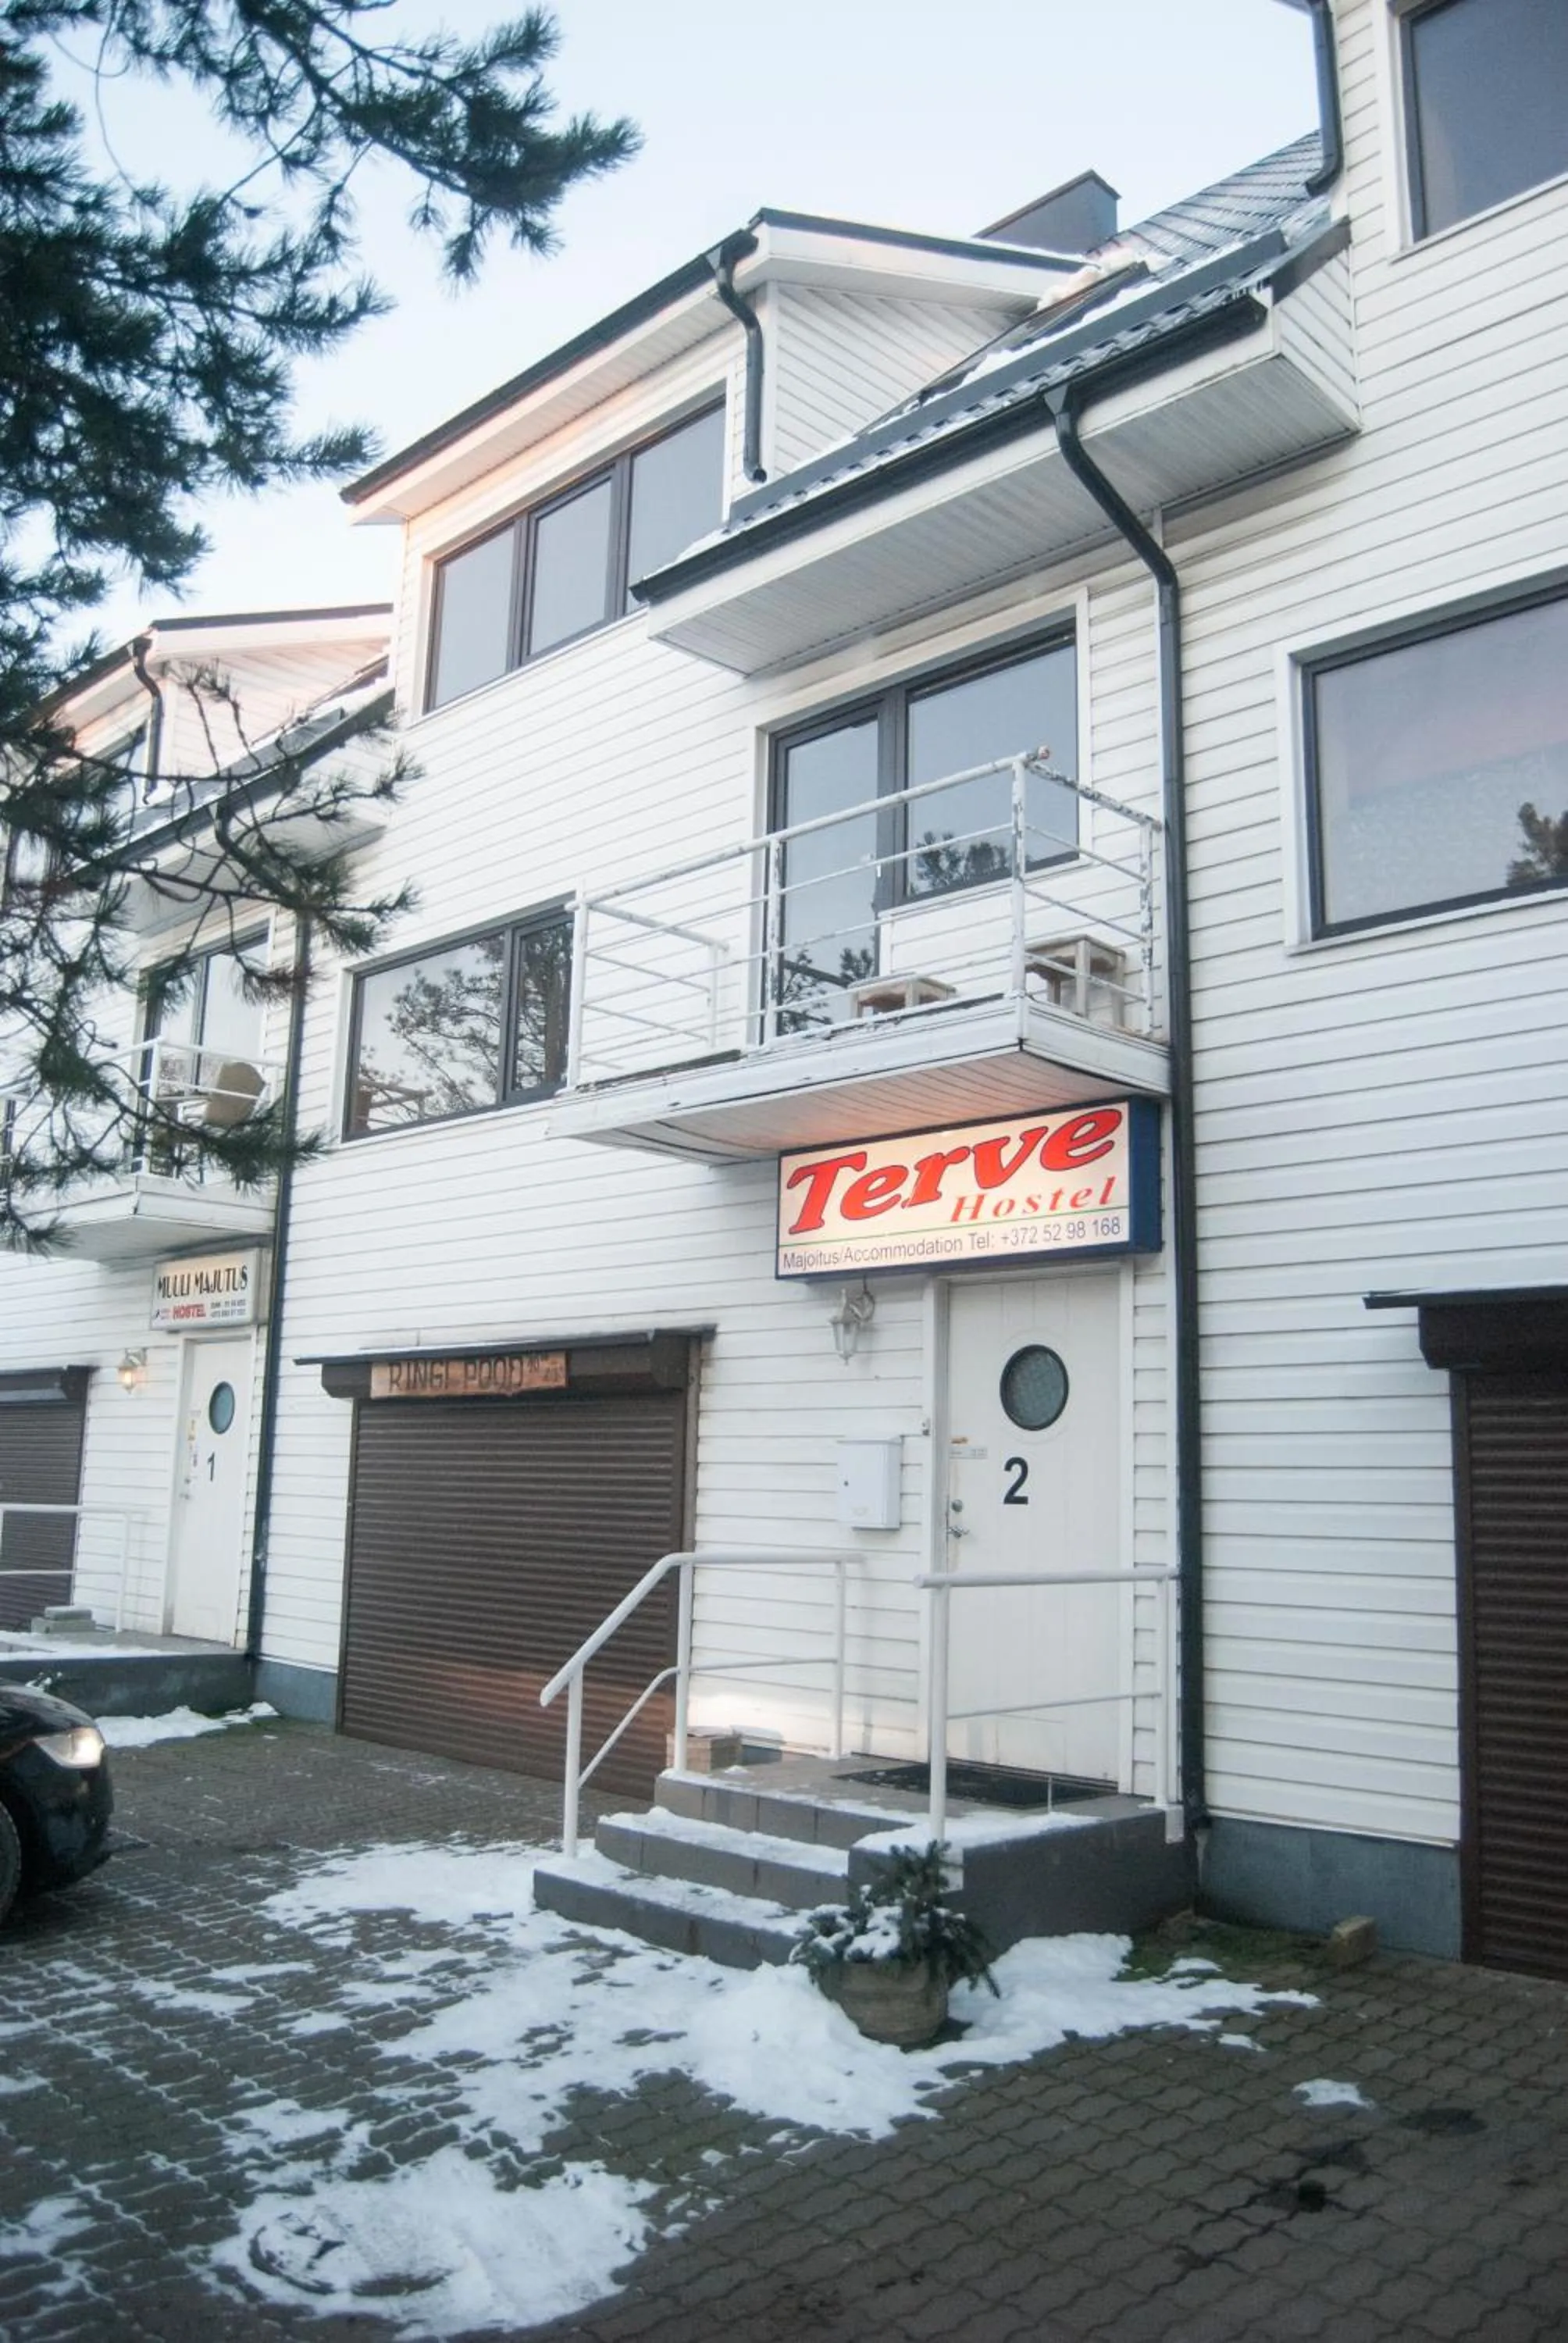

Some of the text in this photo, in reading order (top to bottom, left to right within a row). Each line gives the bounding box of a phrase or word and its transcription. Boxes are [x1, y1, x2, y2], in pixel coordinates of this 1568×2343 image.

[787, 1107, 1123, 1236] Terve
[950, 1175, 1117, 1222] Hostel
[783, 1216, 1121, 1271] Majoitus/Accommodation Tel: +372 52 98 168
[465, 1356, 524, 1390] POOD
[207, 1451, 216, 1482] 1
[1003, 1457, 1029, 1505] 2
